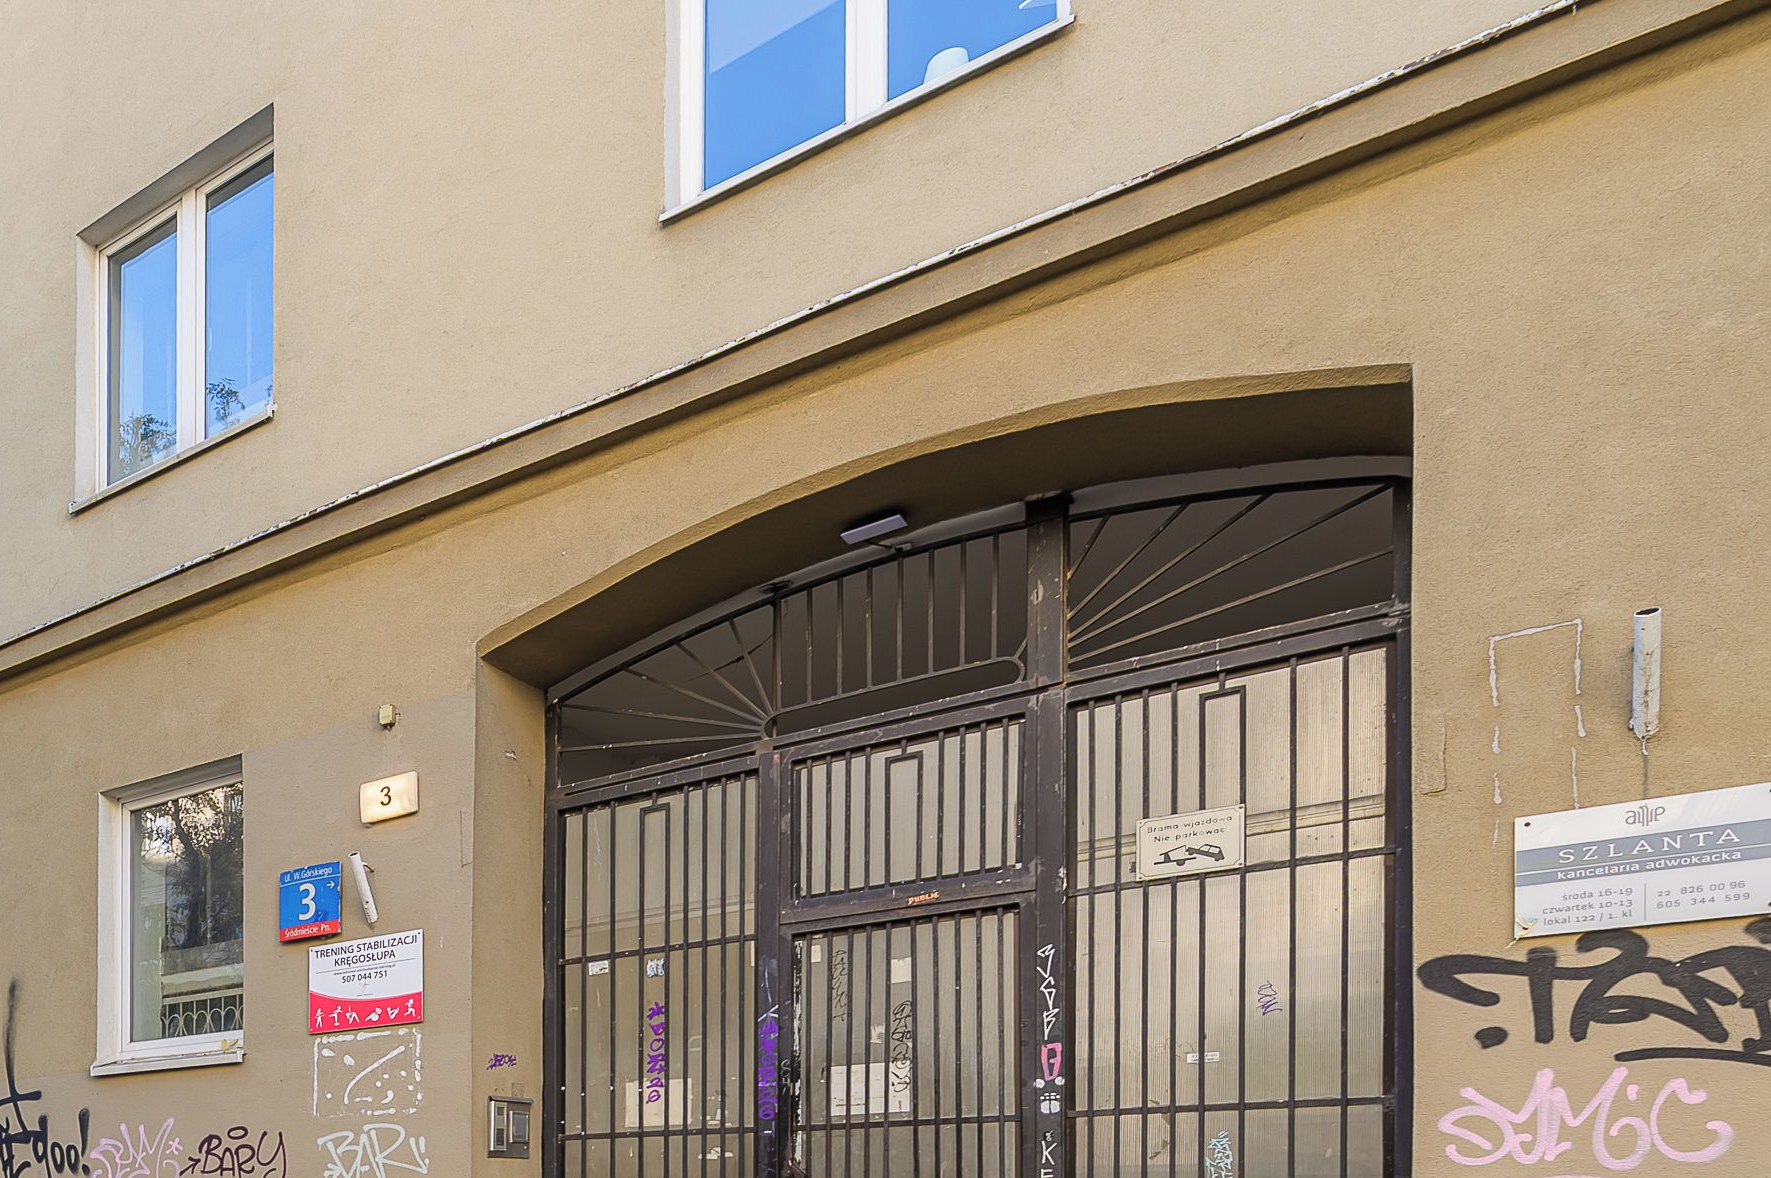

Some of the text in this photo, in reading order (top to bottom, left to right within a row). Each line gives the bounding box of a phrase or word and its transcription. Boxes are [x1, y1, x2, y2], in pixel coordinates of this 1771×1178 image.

[379, 785, 392, 807] 3
[1147, 816, 1233, 834] Brama wjazdowa
[1558, 829, 1741, 864] SZLANTA
[1557, 850, 1742, 881] kancelaria adwokacka
[1562, 887, 1634, 902] środa 16-19
[1656, 880, 1746, 898] 22 826 00 96
[298, 882, 316, 921] 3
[1542, 898, 1634, 915] czwartek 10-13
[1656, 891, 1751, 911] 605 344 599
[1543, 913, 1571, 926] lokal
[1575, 914, 1596, 923] 122
[284, 923, 332, 939] Śródmieście Pn.
[314, 934, 418, 959] TRENING STABILIZACJI
[333, 950, 396, 967] KRĘGOSŁUPA
[341, 974, 356, 984] 507
[357, 971, 372, 982] 044
[374, 969, 388, 979] 751
